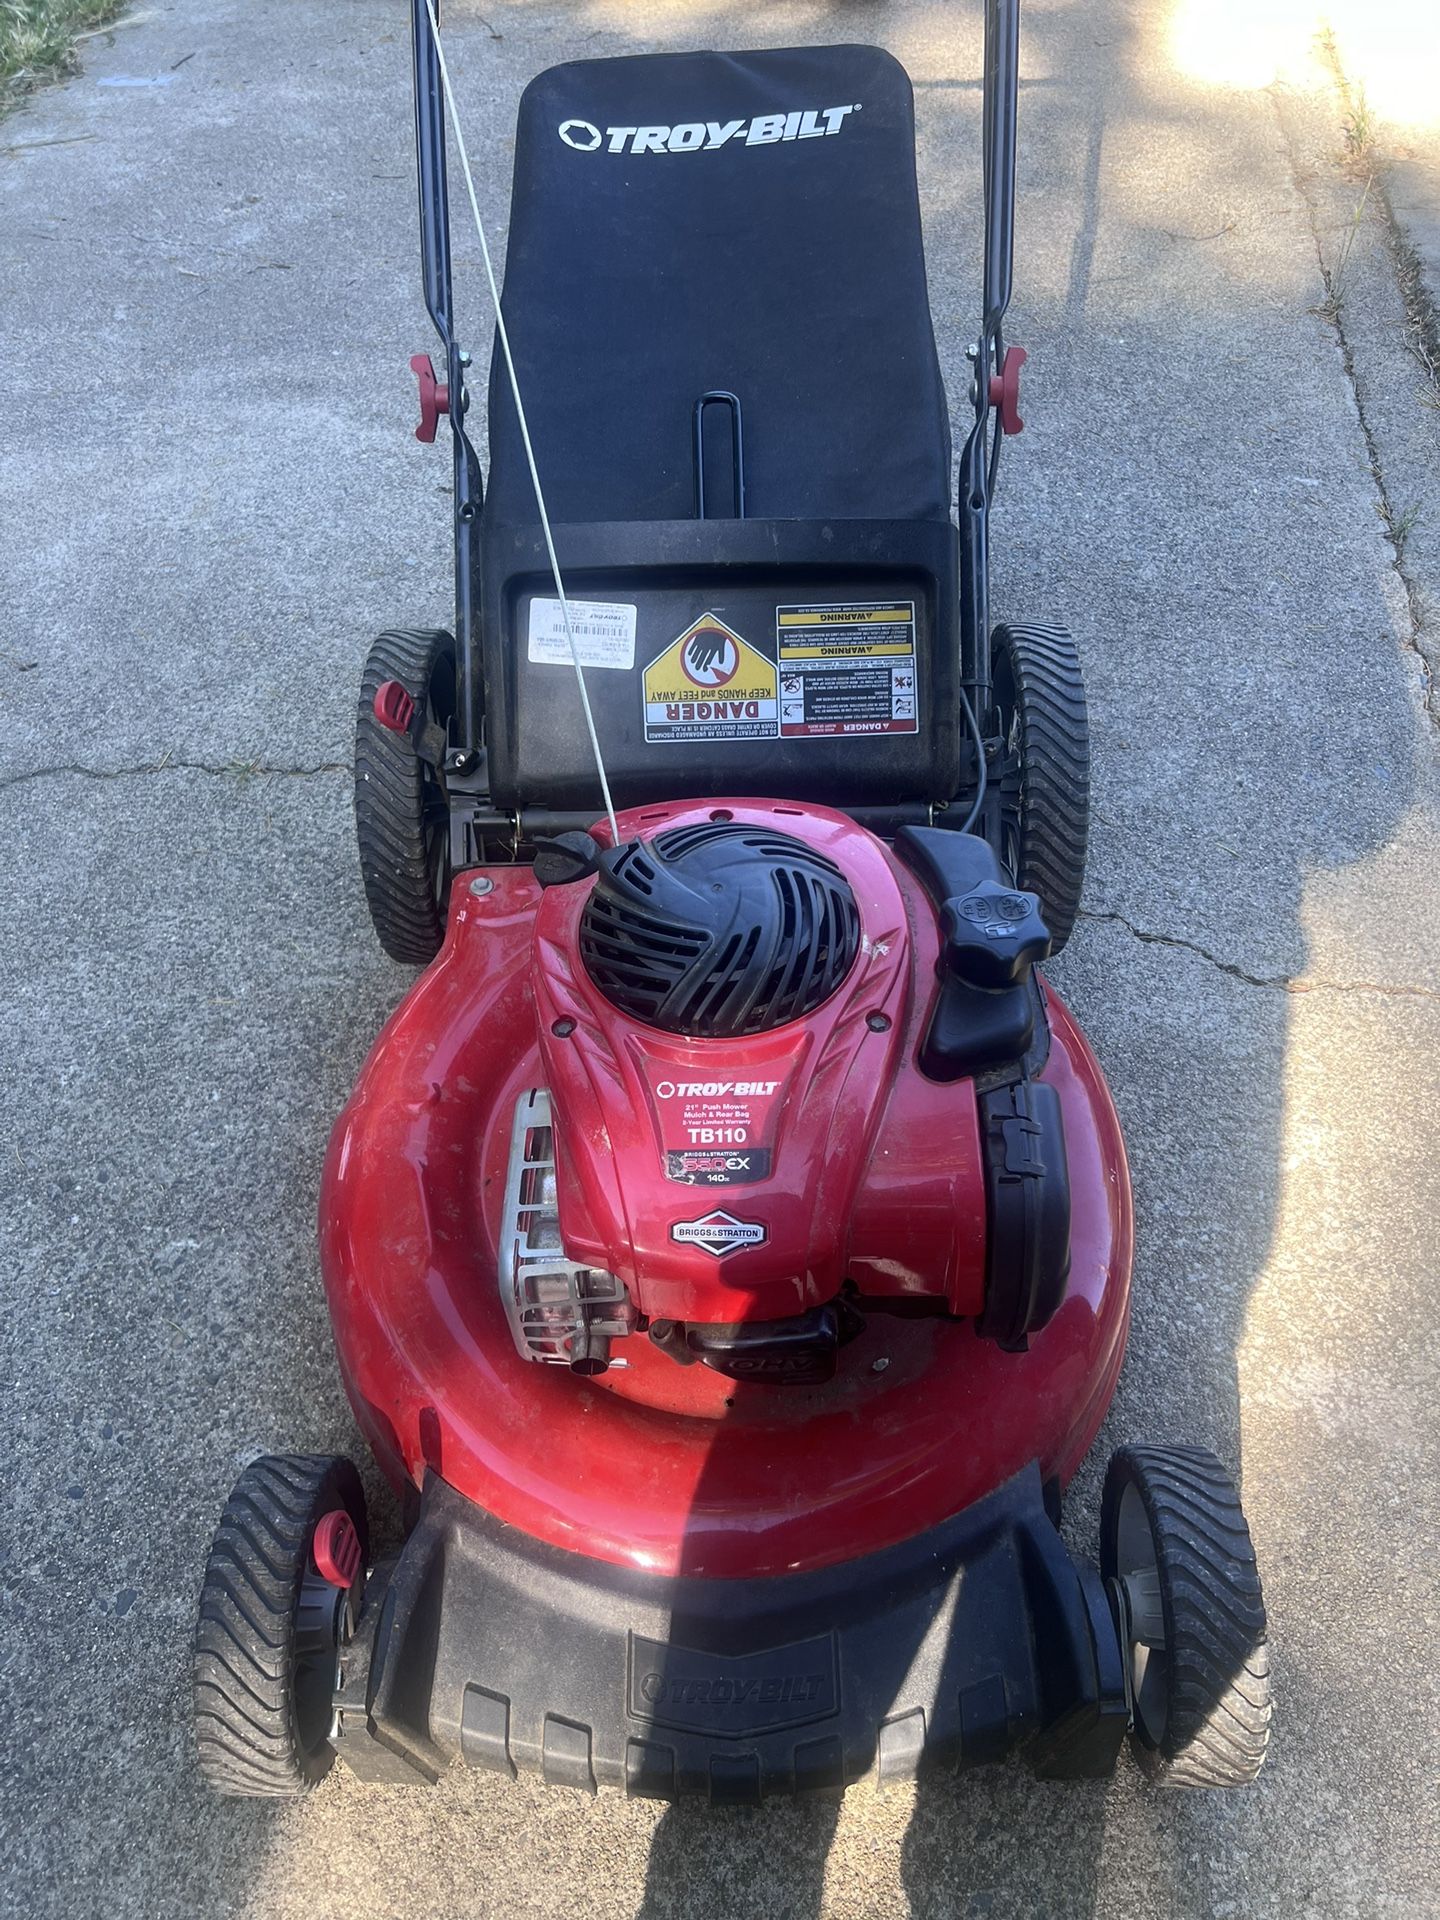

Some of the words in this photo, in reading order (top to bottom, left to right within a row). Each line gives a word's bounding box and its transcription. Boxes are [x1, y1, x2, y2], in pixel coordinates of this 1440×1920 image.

[605, 103, 853, 154] TROY-BILT
[820, 613, 866, 621] WARNING
[651, 691, 676, 701] AWAY
[678, 690, 699, 700] FEET
[701, 690, 716, 699] and
[718, 689, 747, 699] HANDS
[749, 688, 771, 698] KEEP
[666, 701, 759, 720] DANGER
[844, 723, 881, 731] DANGER
[677, 1081, 777, 1097] TROY-BILT
[735, 1111, 750, 1119] Bag
[687, 1128, 747, 1144] TB110
[679, 1228, 758, 1238] BRIGGS&STRATTON
[671, 1674, 824, 1704] TROY-BILT
